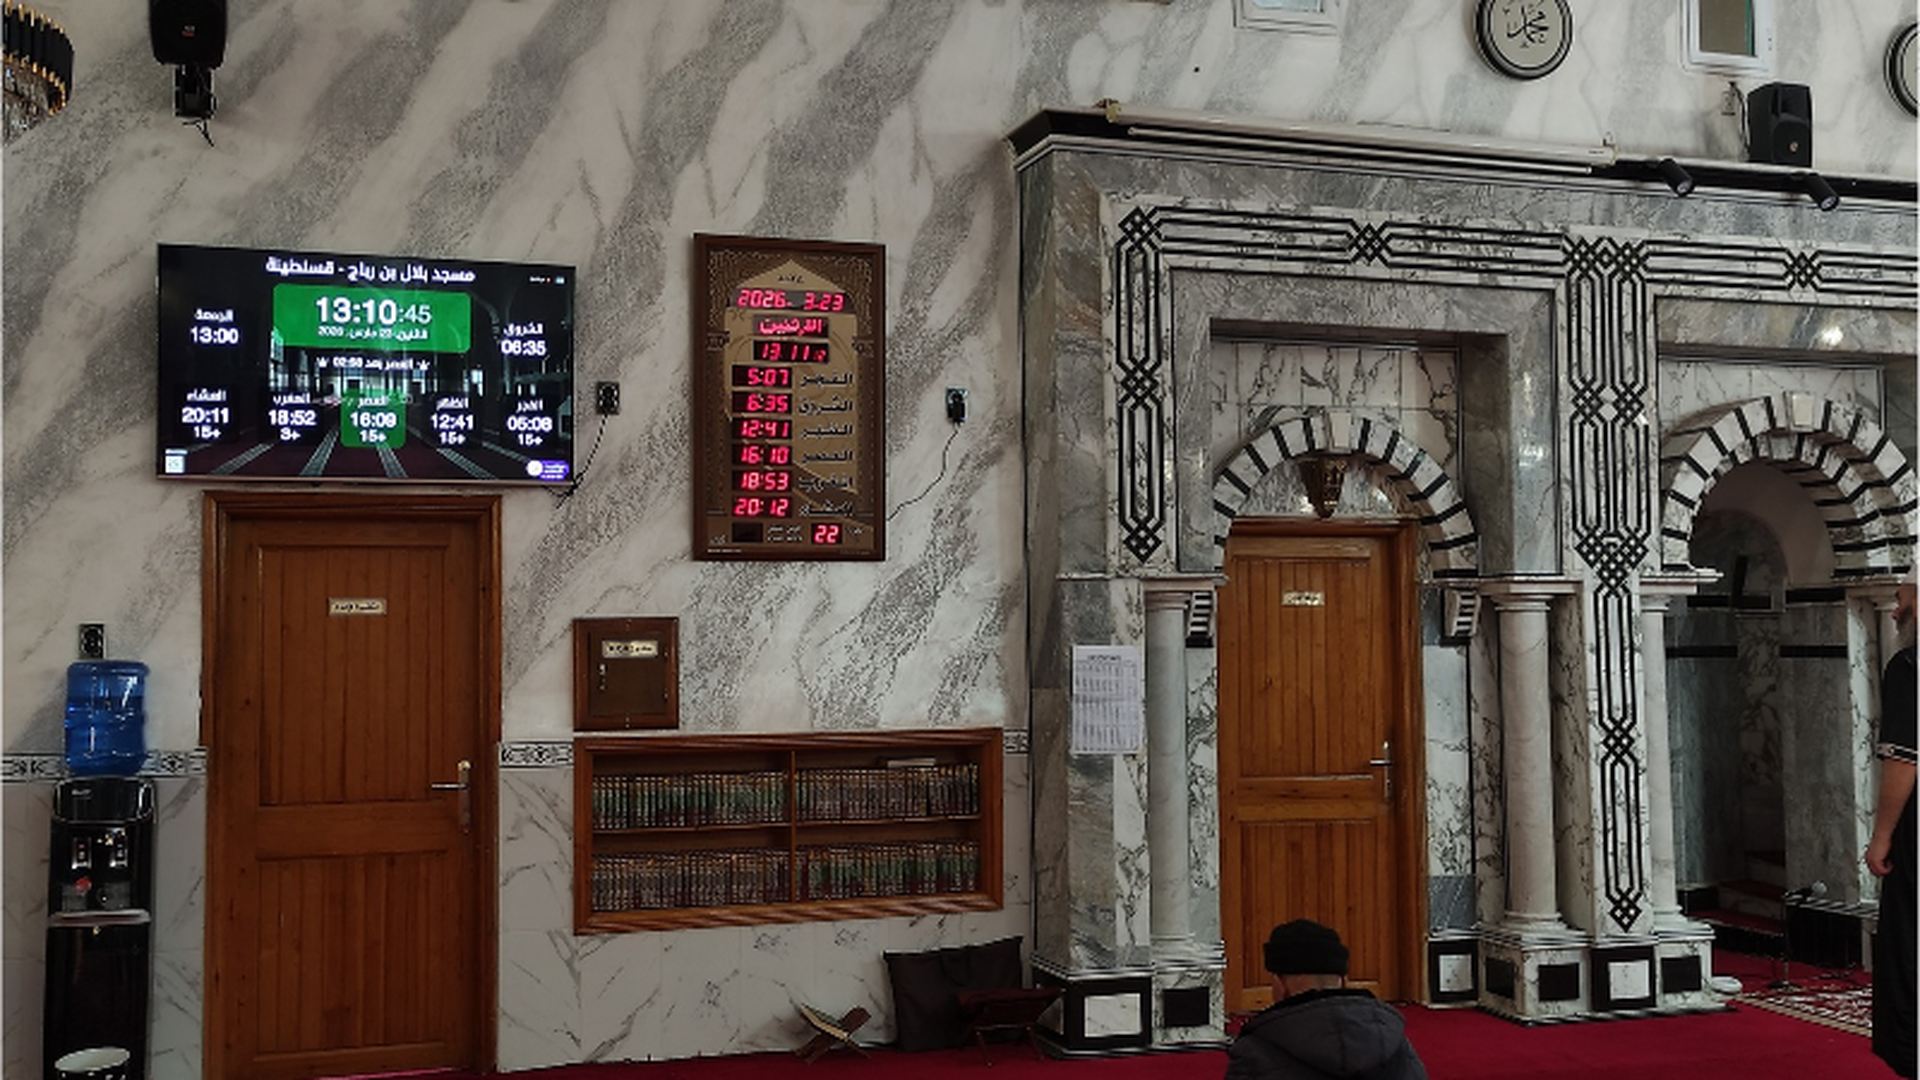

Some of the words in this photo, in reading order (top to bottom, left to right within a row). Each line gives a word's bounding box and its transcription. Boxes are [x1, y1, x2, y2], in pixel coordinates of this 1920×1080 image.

[347, 261, 376, 281] رباح
[378, 266, 397, 281] بن
[400, 264, 428, 283] بلال
[431, 266, 475, 284] مسجد
[316, 296, 431, 325] 13:10:45
[190, 326, 239, 344] 13:00
[501, 339, 547, 356] 06:35
[747, 367, 789, 386] 5:07
[746, 393, 789, 412] 6:35
[181, 406, 229, 424] 20:11
[268, 408, 317, 426] 18:52
[350, 411, 397, 428] 16:09
[430, 412, 474, 430] 12:41
[741, 419, 789, 438] 12:41
[741, 445, 790, 464] 16:10
[740, 472, 790, 491] 18:53
[733, 498, 789, 517] 20:12
[814, 524, 840, 544] 22
